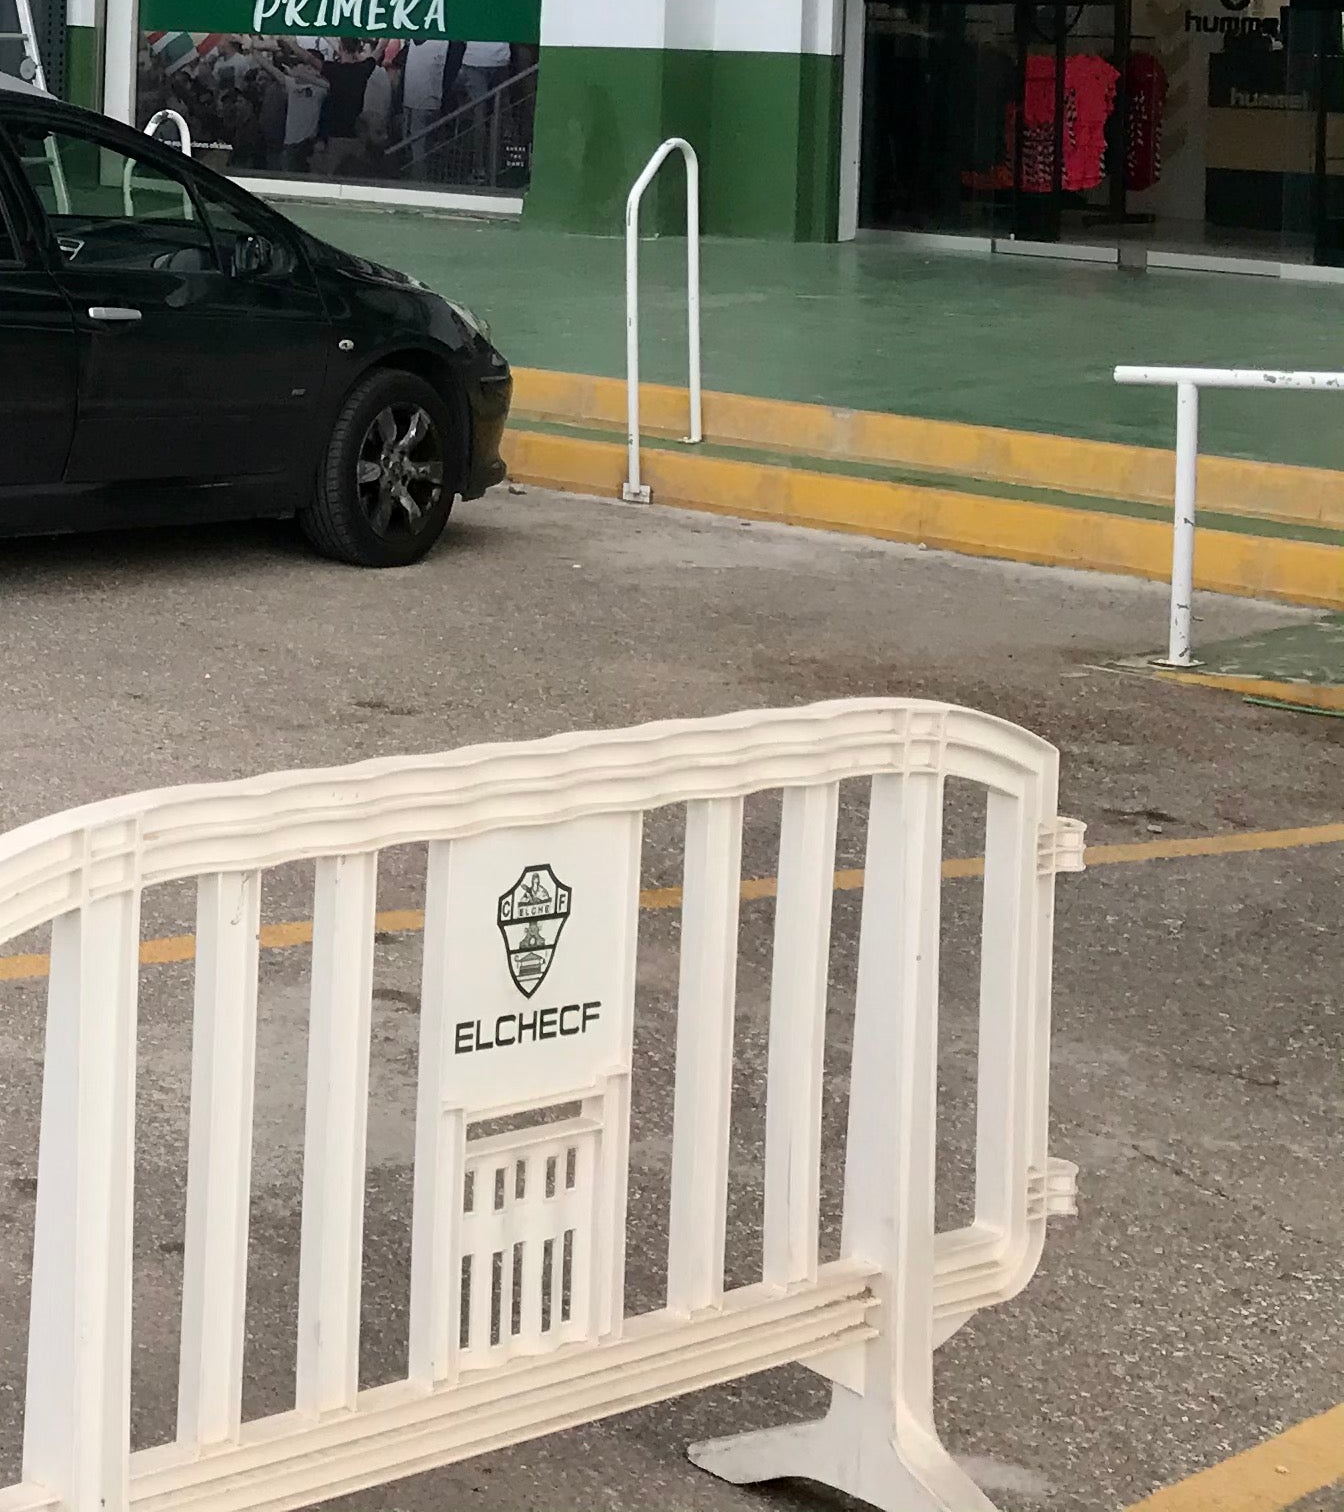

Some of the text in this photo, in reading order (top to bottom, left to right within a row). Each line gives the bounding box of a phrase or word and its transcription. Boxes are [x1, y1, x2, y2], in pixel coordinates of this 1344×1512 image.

[502, 900, 511, 918] C
[558, 893, 566, 912] F
[454, 1001, 602, 1055] ELCHECF
